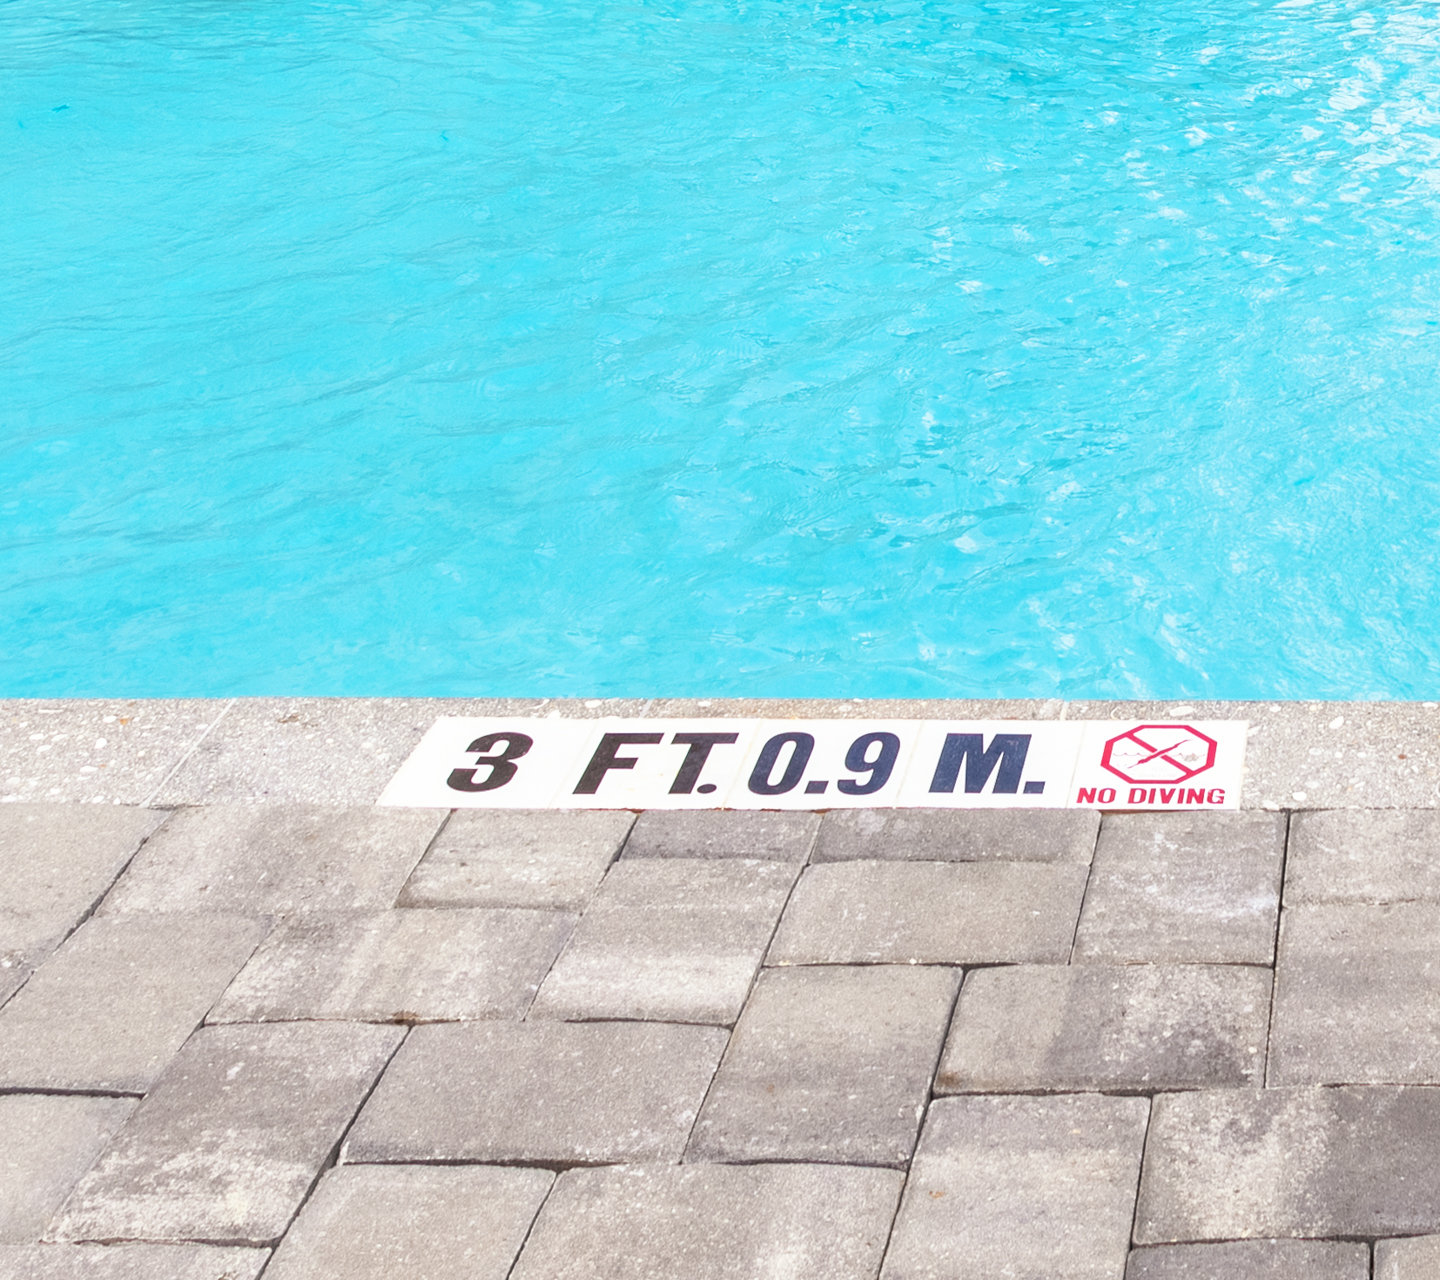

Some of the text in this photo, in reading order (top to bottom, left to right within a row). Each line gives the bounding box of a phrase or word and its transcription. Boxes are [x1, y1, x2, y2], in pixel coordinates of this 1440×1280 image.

[446, 731, 534, 792] 3
[747, 731, 901, 795] 0.9
[928, 732, 1046, 794] M.
[1076, 787, 1225, 805] NO DIVING
